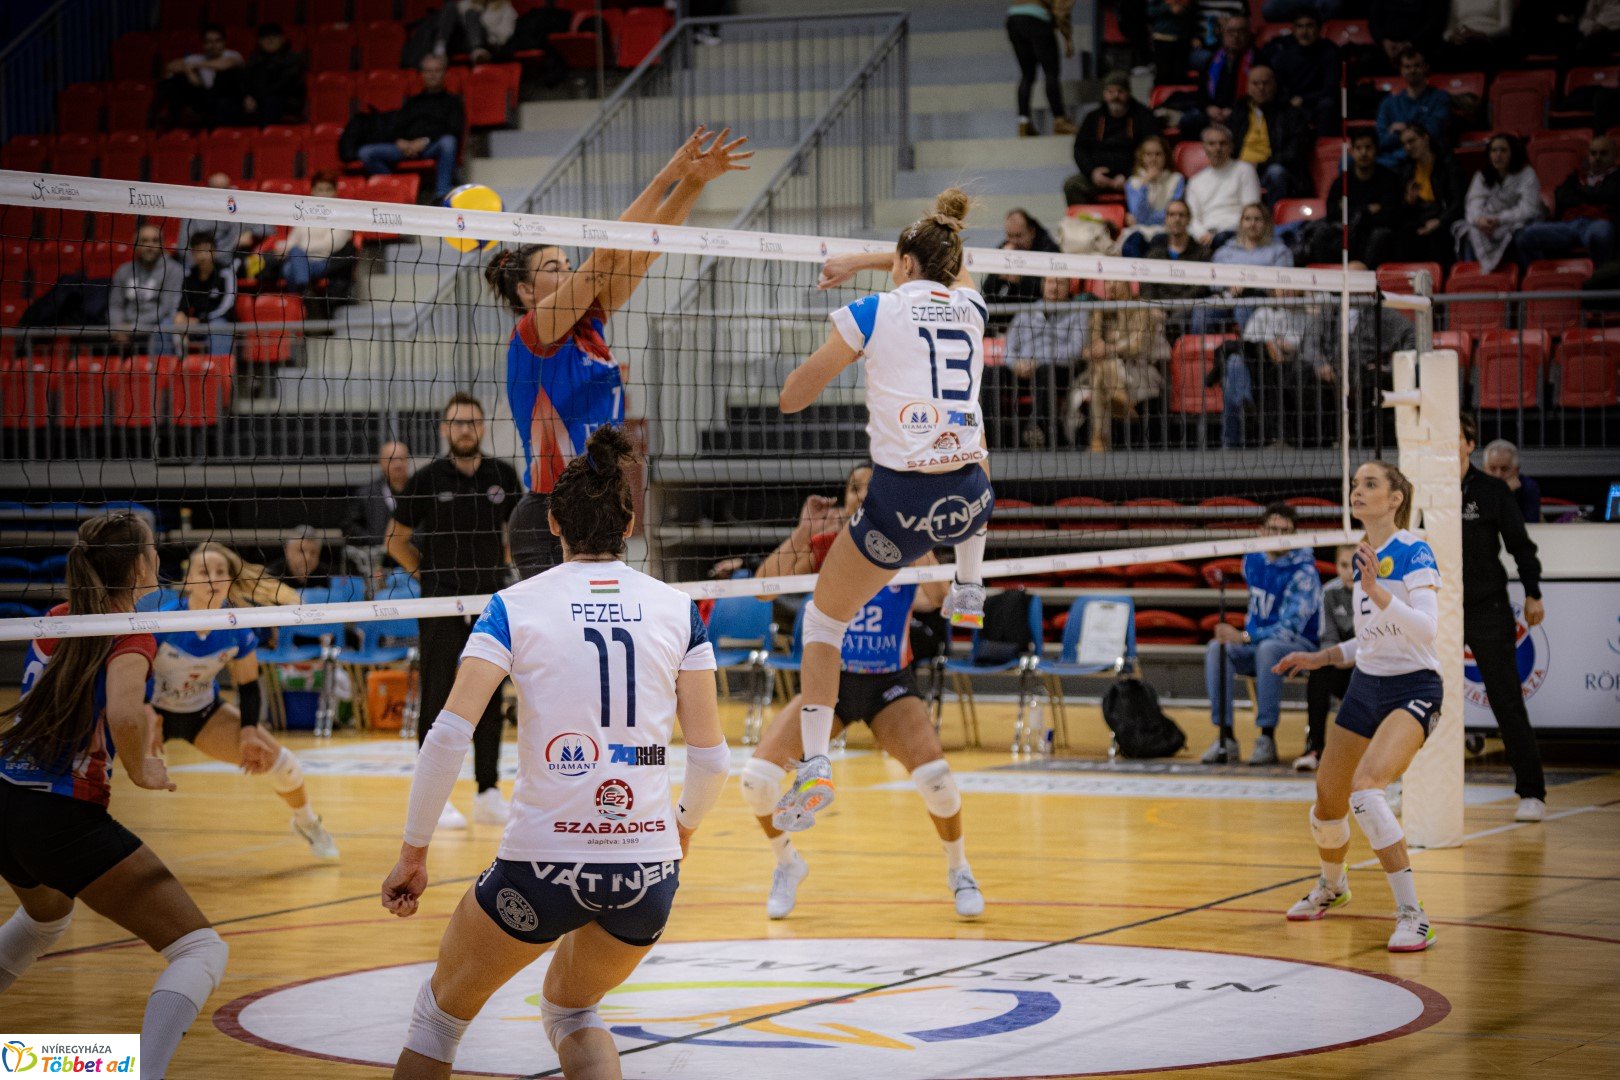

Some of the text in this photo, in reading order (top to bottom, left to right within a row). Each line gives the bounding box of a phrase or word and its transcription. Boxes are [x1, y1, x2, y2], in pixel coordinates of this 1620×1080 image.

[918, 326, 974, 401] 13
[571, 603, 643, 623] PEZELJ
[848, 605, 883, 633] 22
[842, 633, 897, 651] ATUM
[583, 627, 636, 727] 11
[1585, 671, 1620, 691] RÖ
[549, 762, 597, 770] DIAMANT
[605, 792, 625, 805] SZ
[553, 820, 666, 834] SZABADICS
[622, 837, 640, 845] 1989
